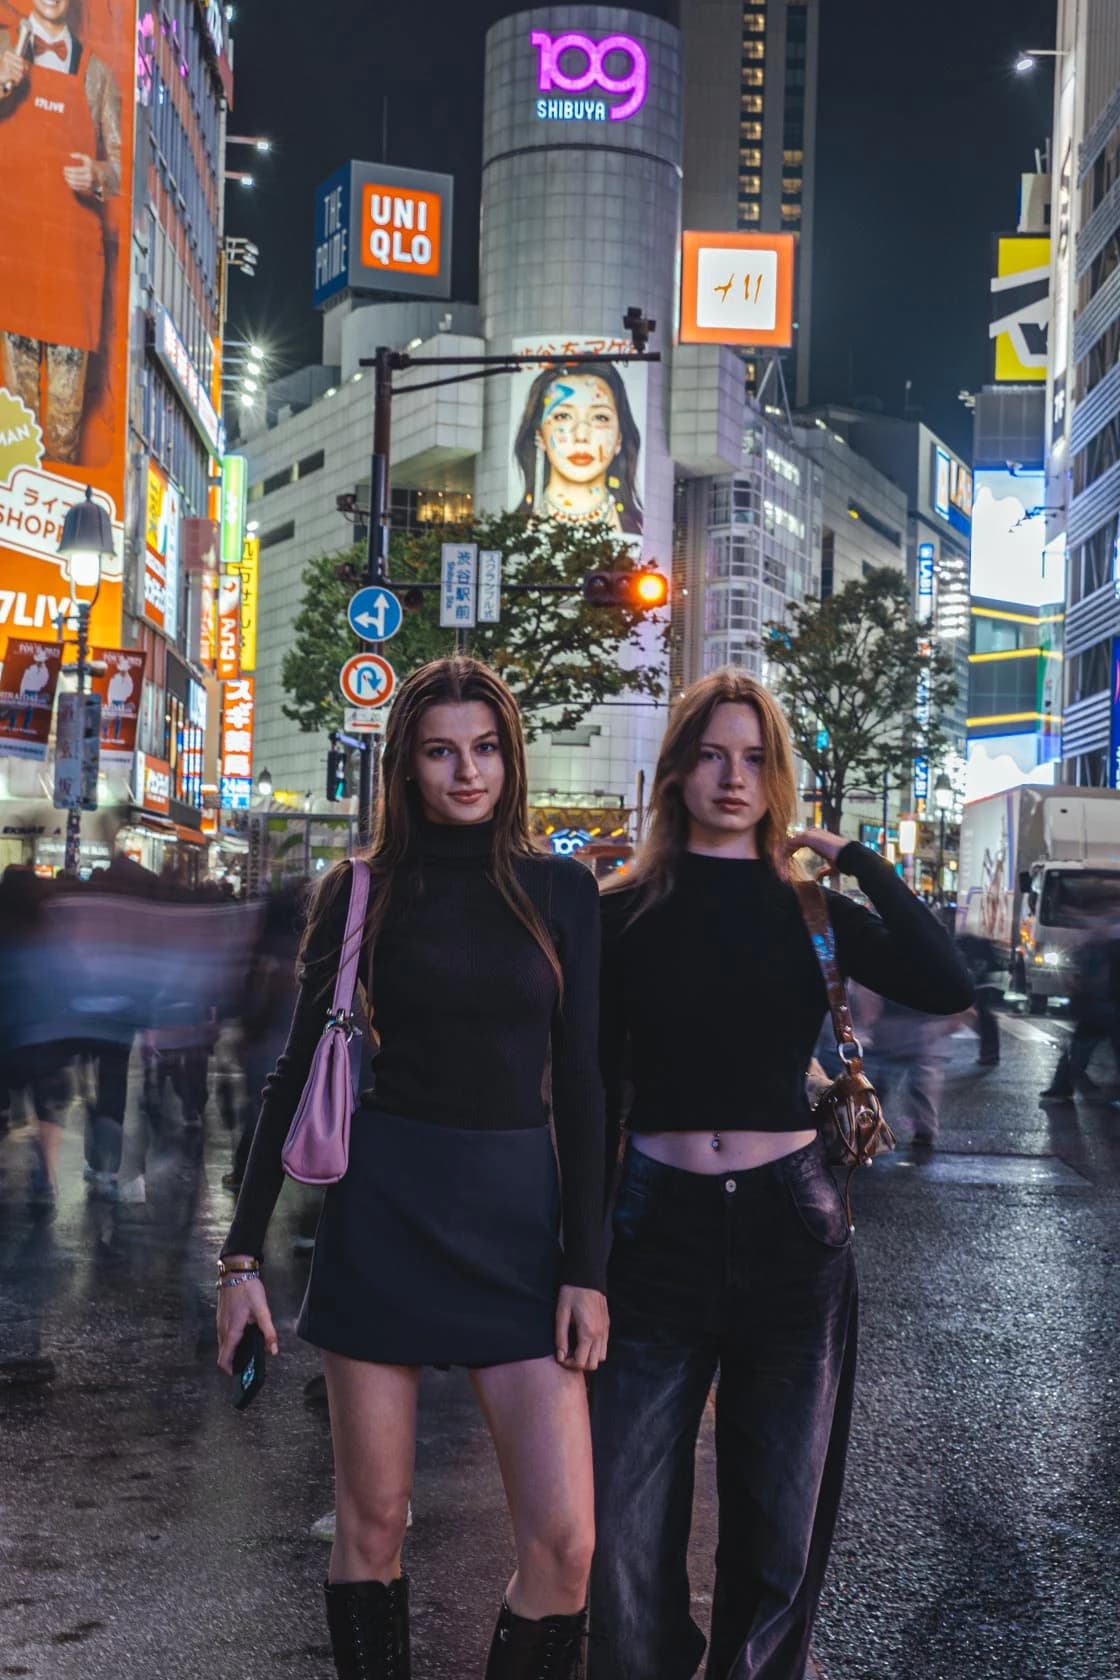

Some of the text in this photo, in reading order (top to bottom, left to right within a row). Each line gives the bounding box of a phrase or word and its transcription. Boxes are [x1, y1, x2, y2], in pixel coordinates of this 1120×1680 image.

[531, 31, 648, 120] 109
[536, 99, 606, 120] SHIBUYA
[324, 185, 342, 239] THE
[370, 193, 428, 232] UNI
[369, 228, 432, 265] QLO
[455, 551, 472, 619] 渋谷駅前
[484, 554, 497, 618] スクランブル式
[224, 680, 254, 776] スギ
